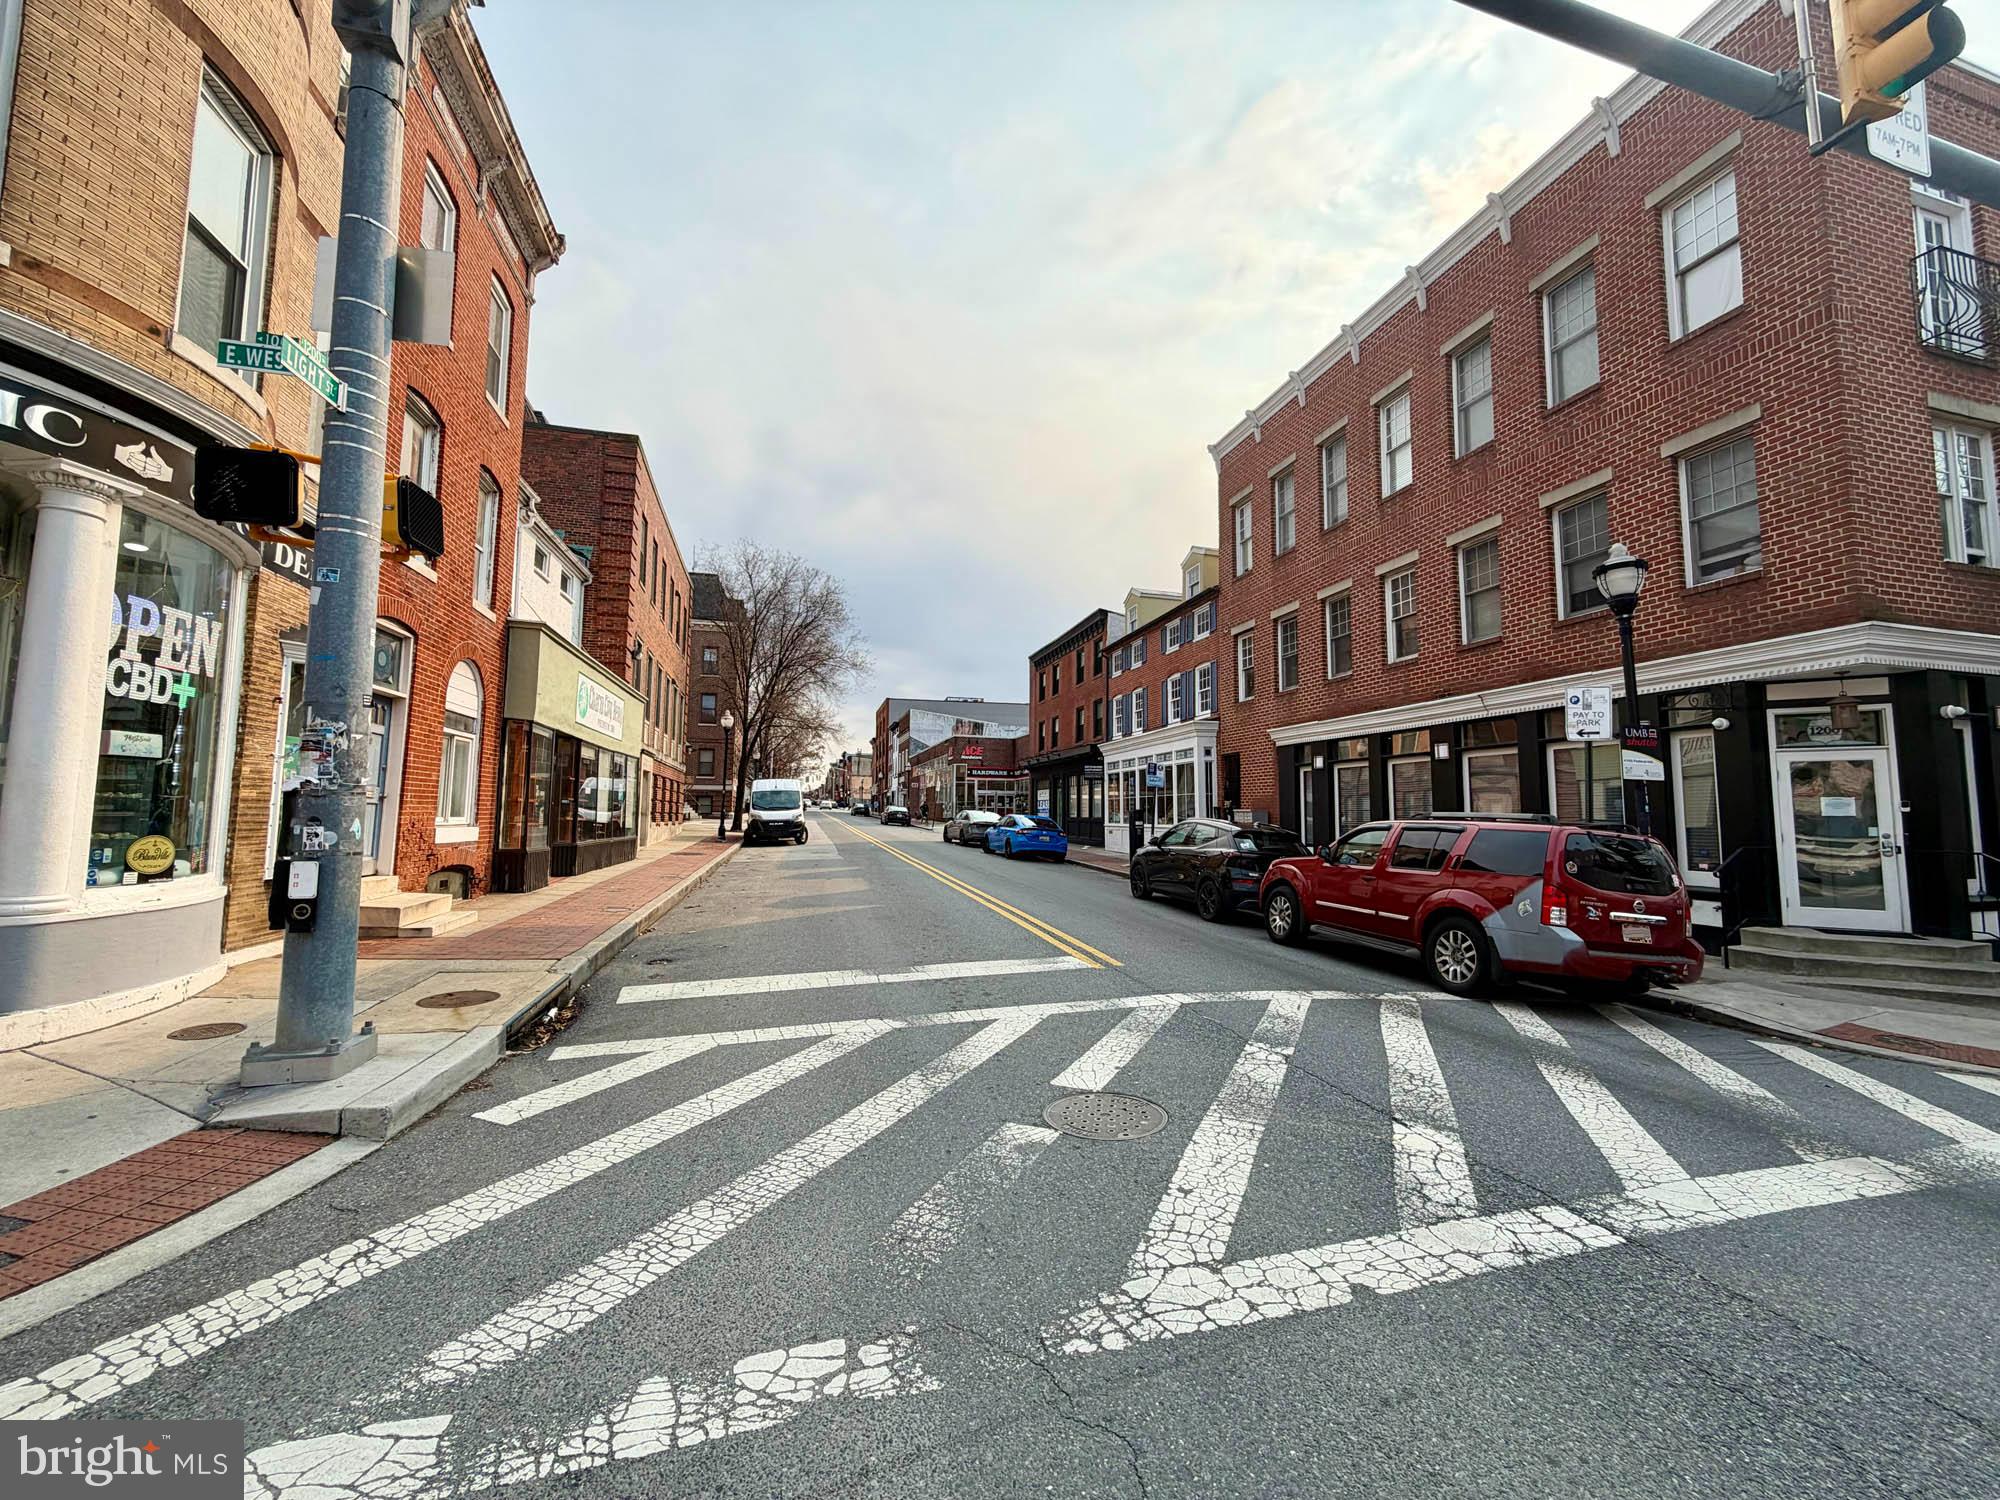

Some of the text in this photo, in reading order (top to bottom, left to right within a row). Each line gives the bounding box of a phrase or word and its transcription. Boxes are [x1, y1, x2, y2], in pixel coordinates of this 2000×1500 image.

[1875, 127, 1920, 157] 7AM-7PM
[265, 334, 282, 346] 10
[226, 344, 283, 370] E. WES
[287, 343, 325, 391] LIGHT
[273, 542, 313, 580] DE
[1573, 711, 1605, 719] PAY TO
[1576, 719, 1600, 727] PARK
[1625, 728, 1648, 738] UMB
[1625, 738, 1657, 746] shuttle
[962, 746, 984, 755] ACE
[972, 768, 1008, 776] HARDWARE
